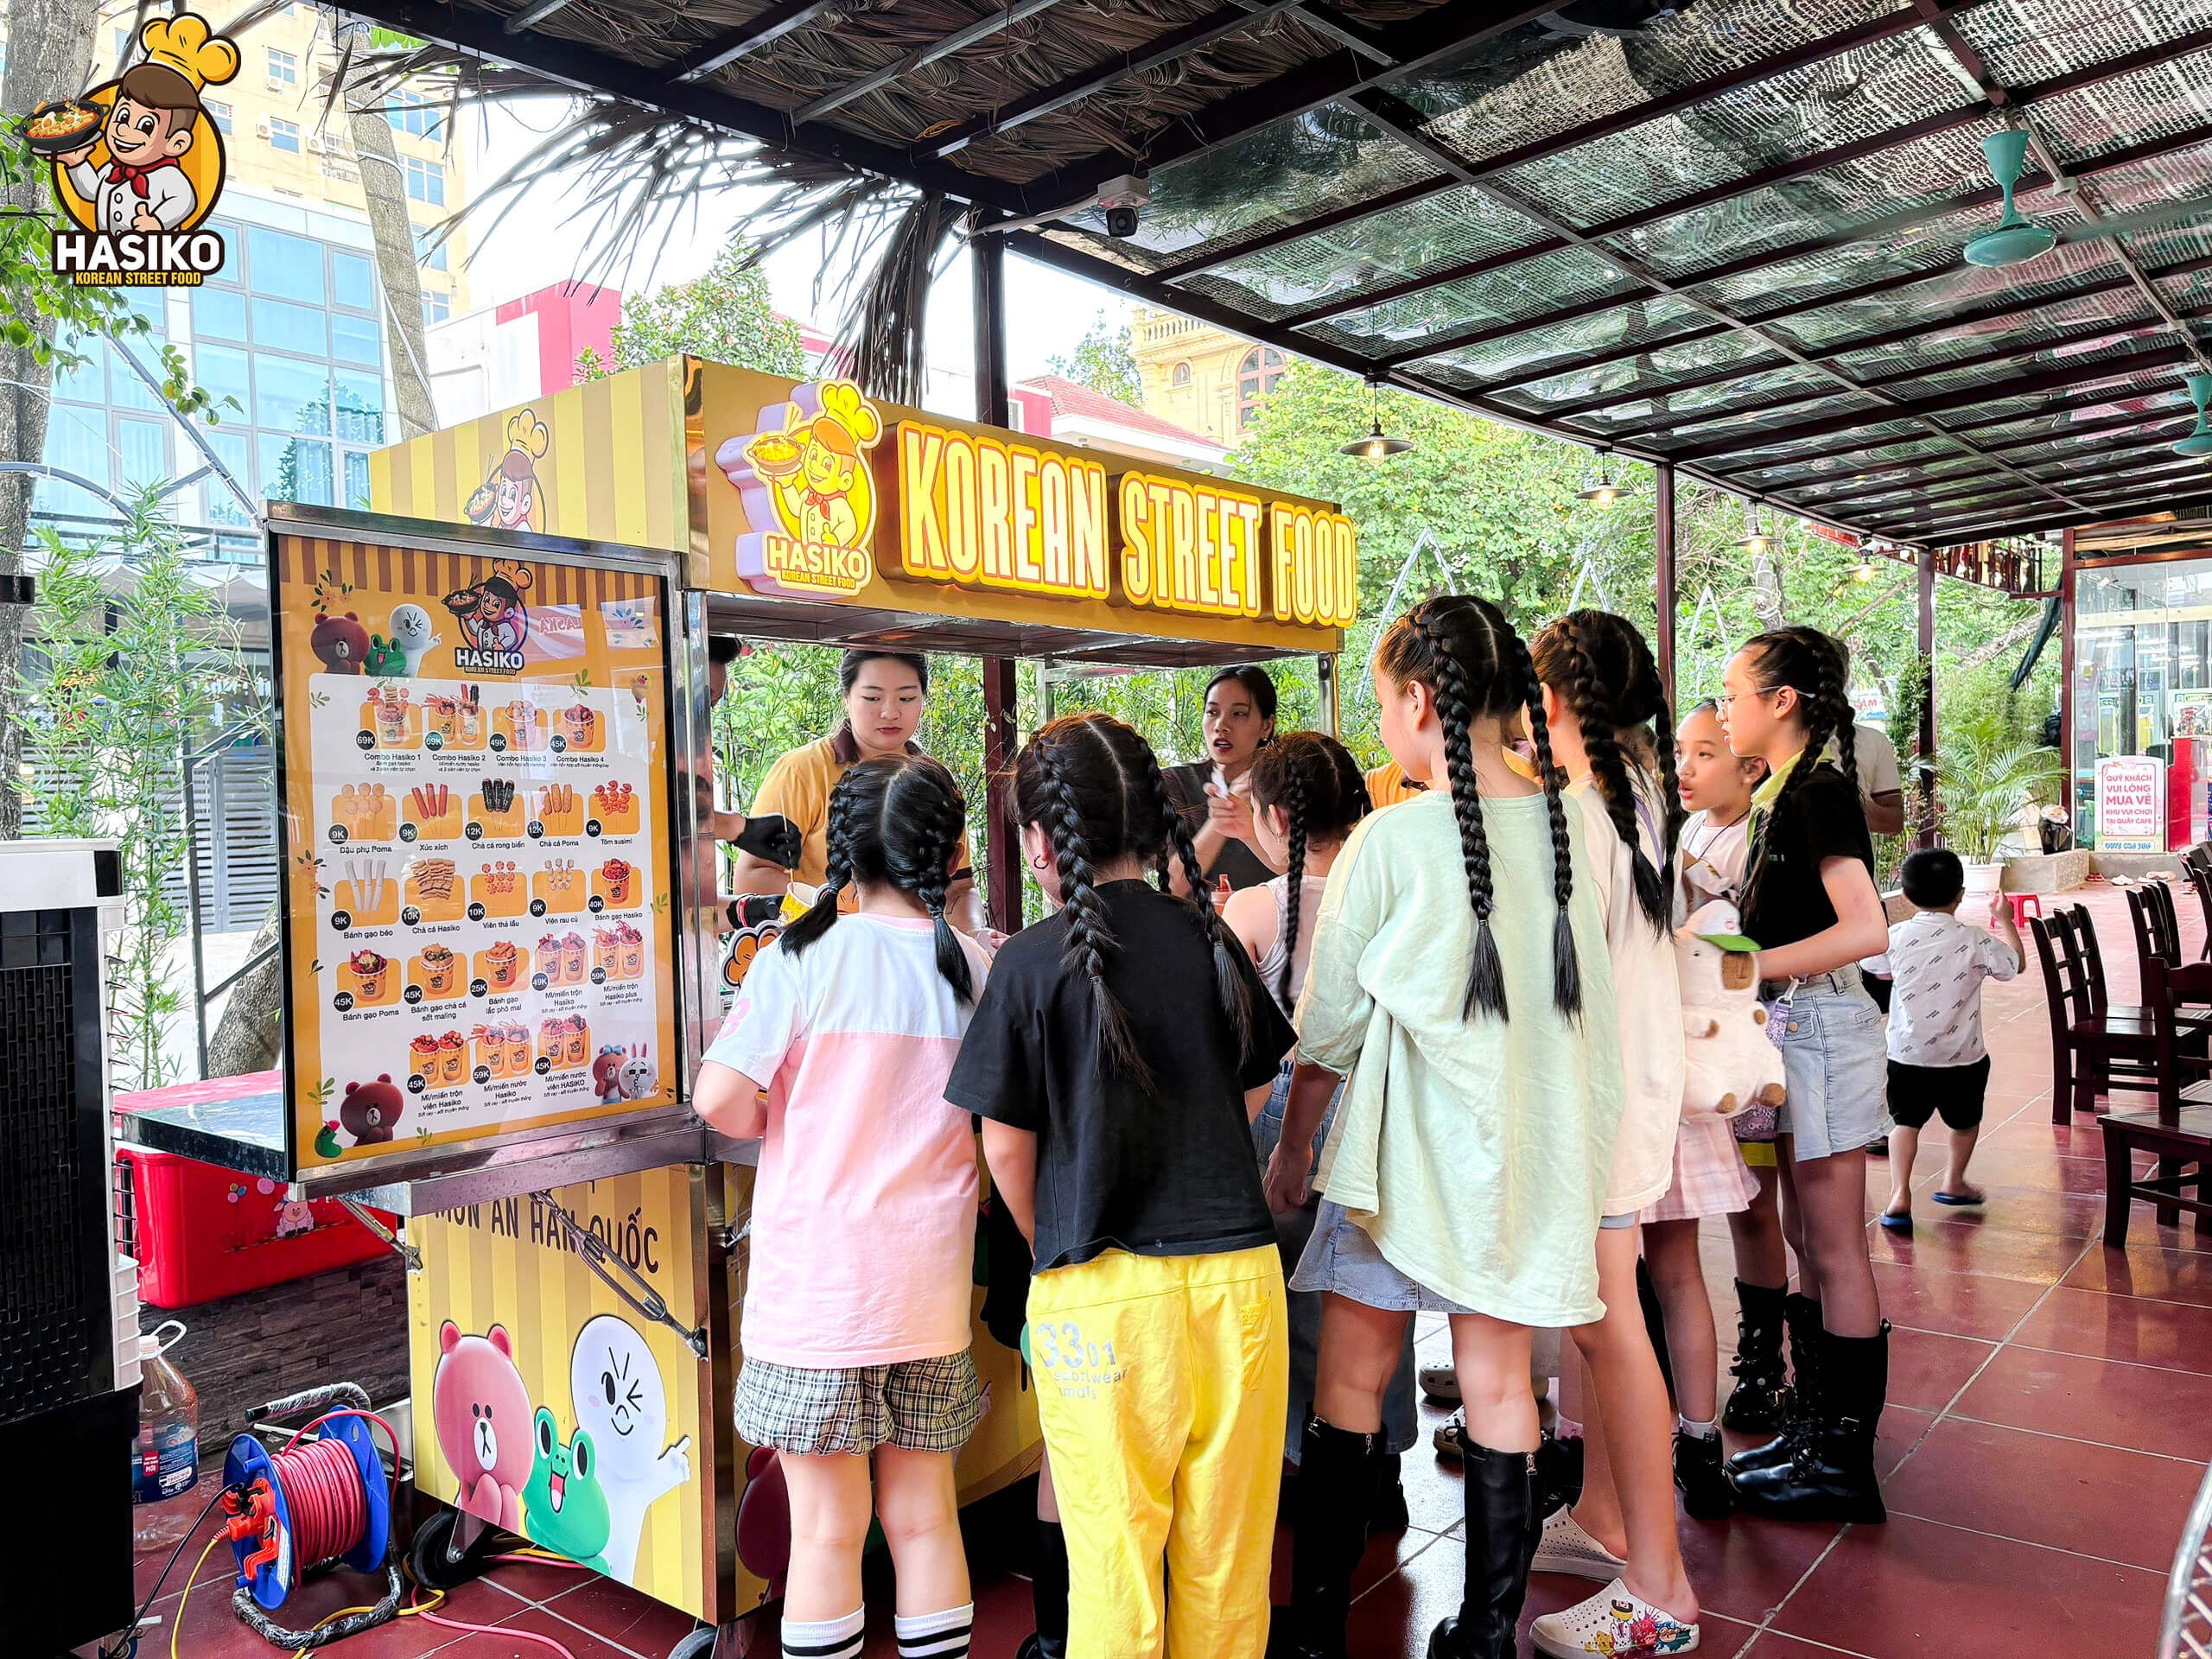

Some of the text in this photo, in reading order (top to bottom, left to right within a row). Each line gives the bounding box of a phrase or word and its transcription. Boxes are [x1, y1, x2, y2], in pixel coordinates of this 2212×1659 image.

[904, 427, 1356, 624] KOREAN STREET FOOD
[768, 537, 866, 579] HASIKO
[781, 570, 855, 588] KOREAN STREET FOOD
[456, 649, 523, 671] HASIKO
[357, 735, 374, 745] 69K
[426, 737, 443, 746] 69K
[490, 738, 505, 747] 49K
[2106, 795, 2133, 805] MUA
[529, 824, 543, 833] 12K
[469, 907, 485, 916] 10K
[404, 912, 419, 921] 10K
[344, 931, 363, 939] Bánh
[532, 978, 548, 987] 49K
[470, 984, 486, 993] 25K
[334, 997, 353, 1006] 45K
[342, 1013, 362, 1021] Bánh
[535, 1061, 550, 1070] 45K
[407, 1079, 424, 1088] 45K
[561, 1078, 585, 1089] HASIKO
[495, 1090, 517, 1099] Hasiko
[438, 1099, 461, 1108] Hasiko
